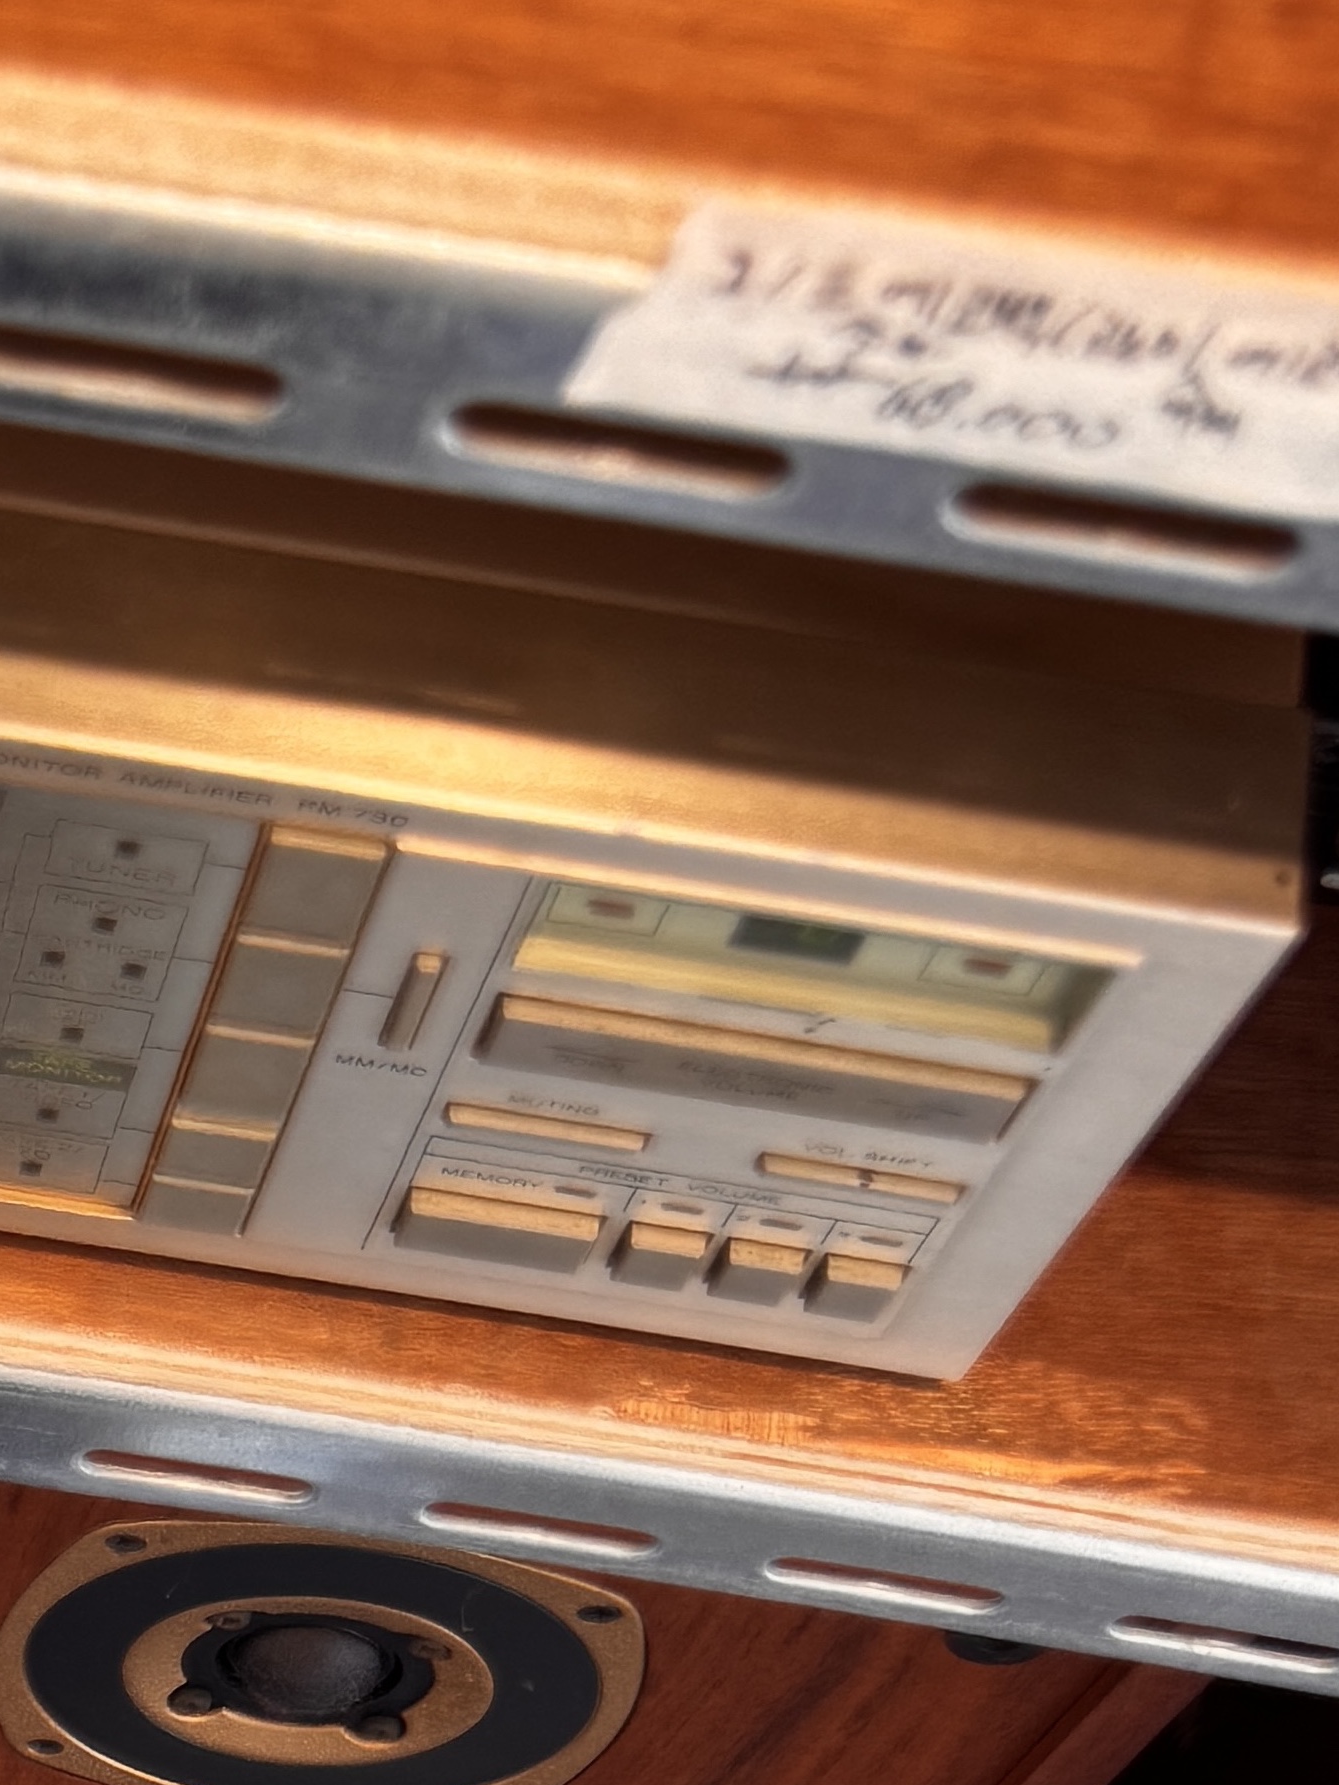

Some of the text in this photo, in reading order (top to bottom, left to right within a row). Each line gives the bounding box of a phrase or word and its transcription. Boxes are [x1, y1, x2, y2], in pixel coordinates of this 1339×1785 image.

[118, 770, 272, 806] AMPLIFIER
[70, 858, 177, 887] TUNER
[54, 894, 166, 921] PHONO
[4, 1057, 122, 1084] MONITOR
[439, 1165, 545, 1190] MEMORY
[578, 1163, 783, 1207] PRESET VOLUME
